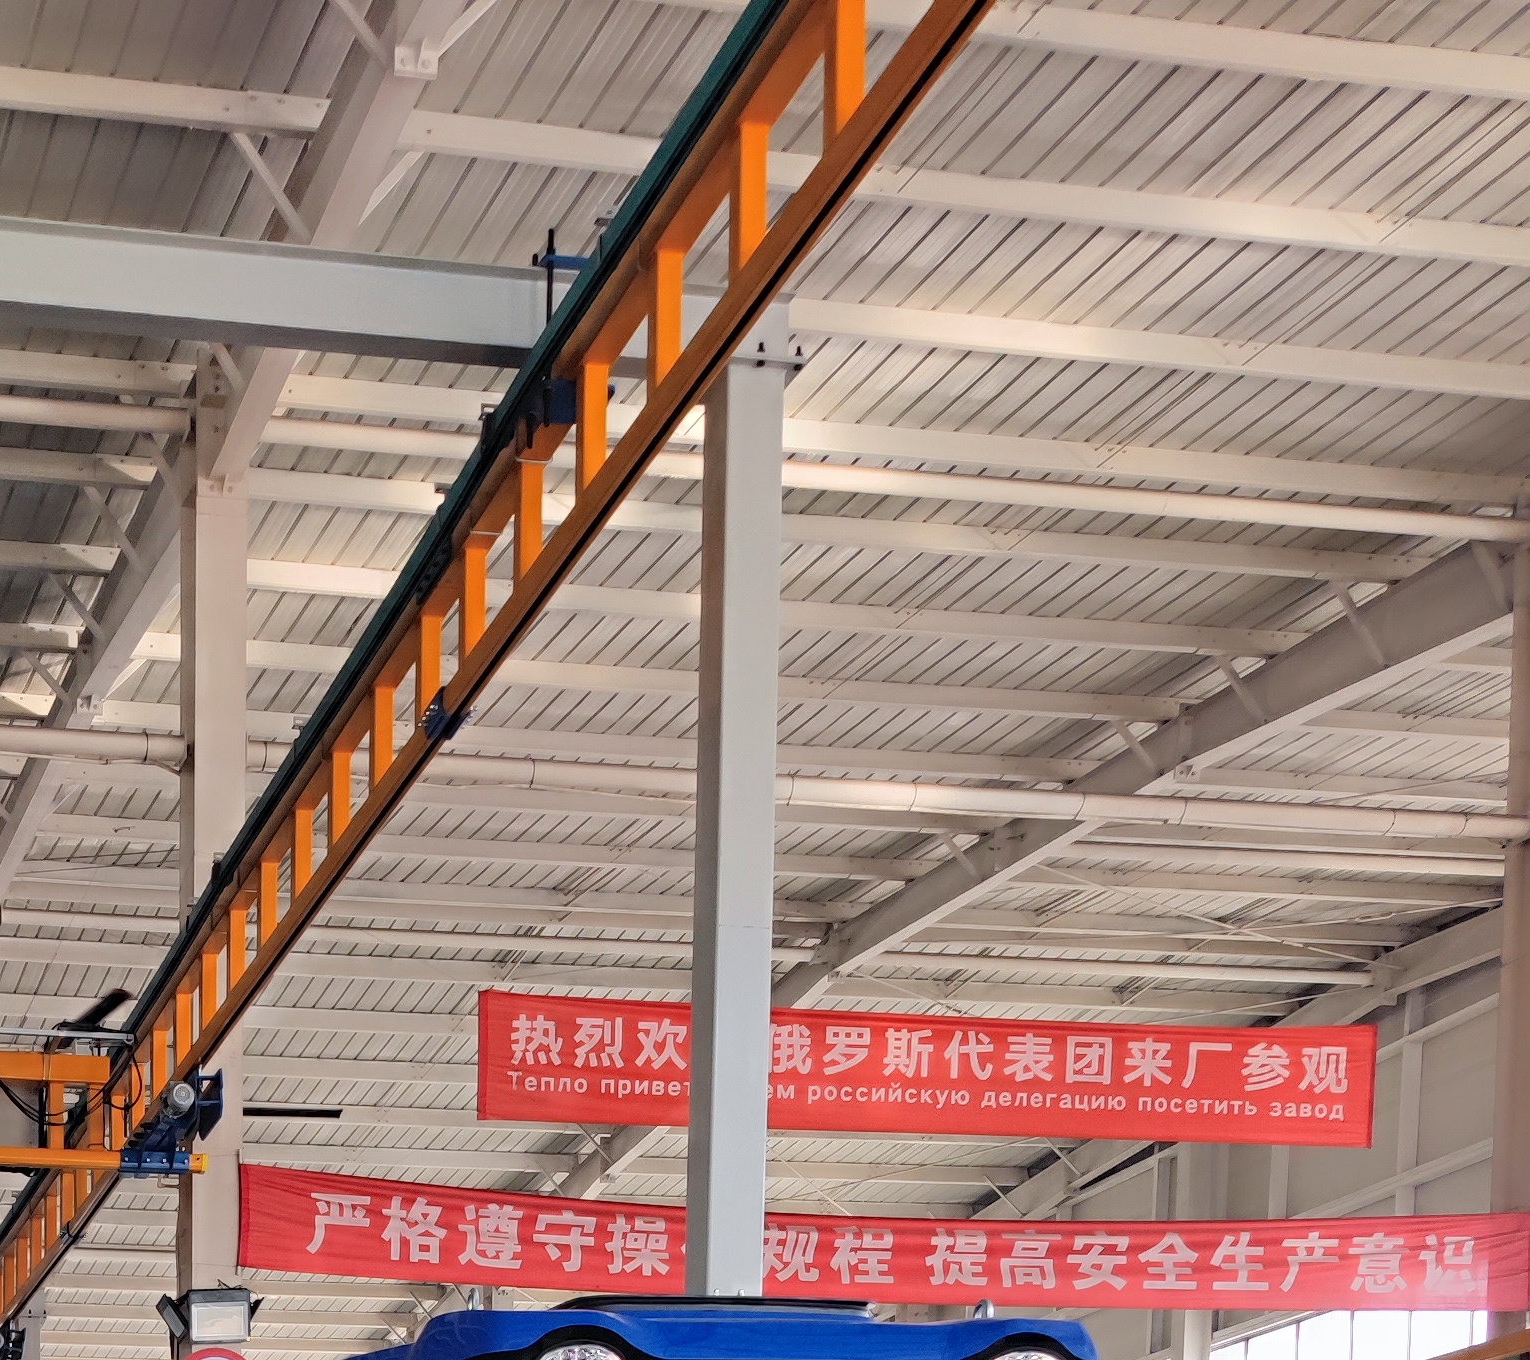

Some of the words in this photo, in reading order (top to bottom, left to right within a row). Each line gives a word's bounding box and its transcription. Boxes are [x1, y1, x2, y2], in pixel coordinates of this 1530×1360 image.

[511, 1013, 1348, 1094] 热烈欢俄罗斯代表团来厂参观
[507, 1070, 588, 1094] Тепло
[600, 1078, 796, 1100] приветем
[807, 1082, 970, 1109] российскую
[980, 1091, 1127, 1111] делегацию
[1138, 1096, 1258, 1116] посетить
[1269, 1101, 1345, 1122] завод
[306, 1191, 895, 1285] 严格遵守操规程
[924, 1228, 1478, 1294] 提高安全生产意识
